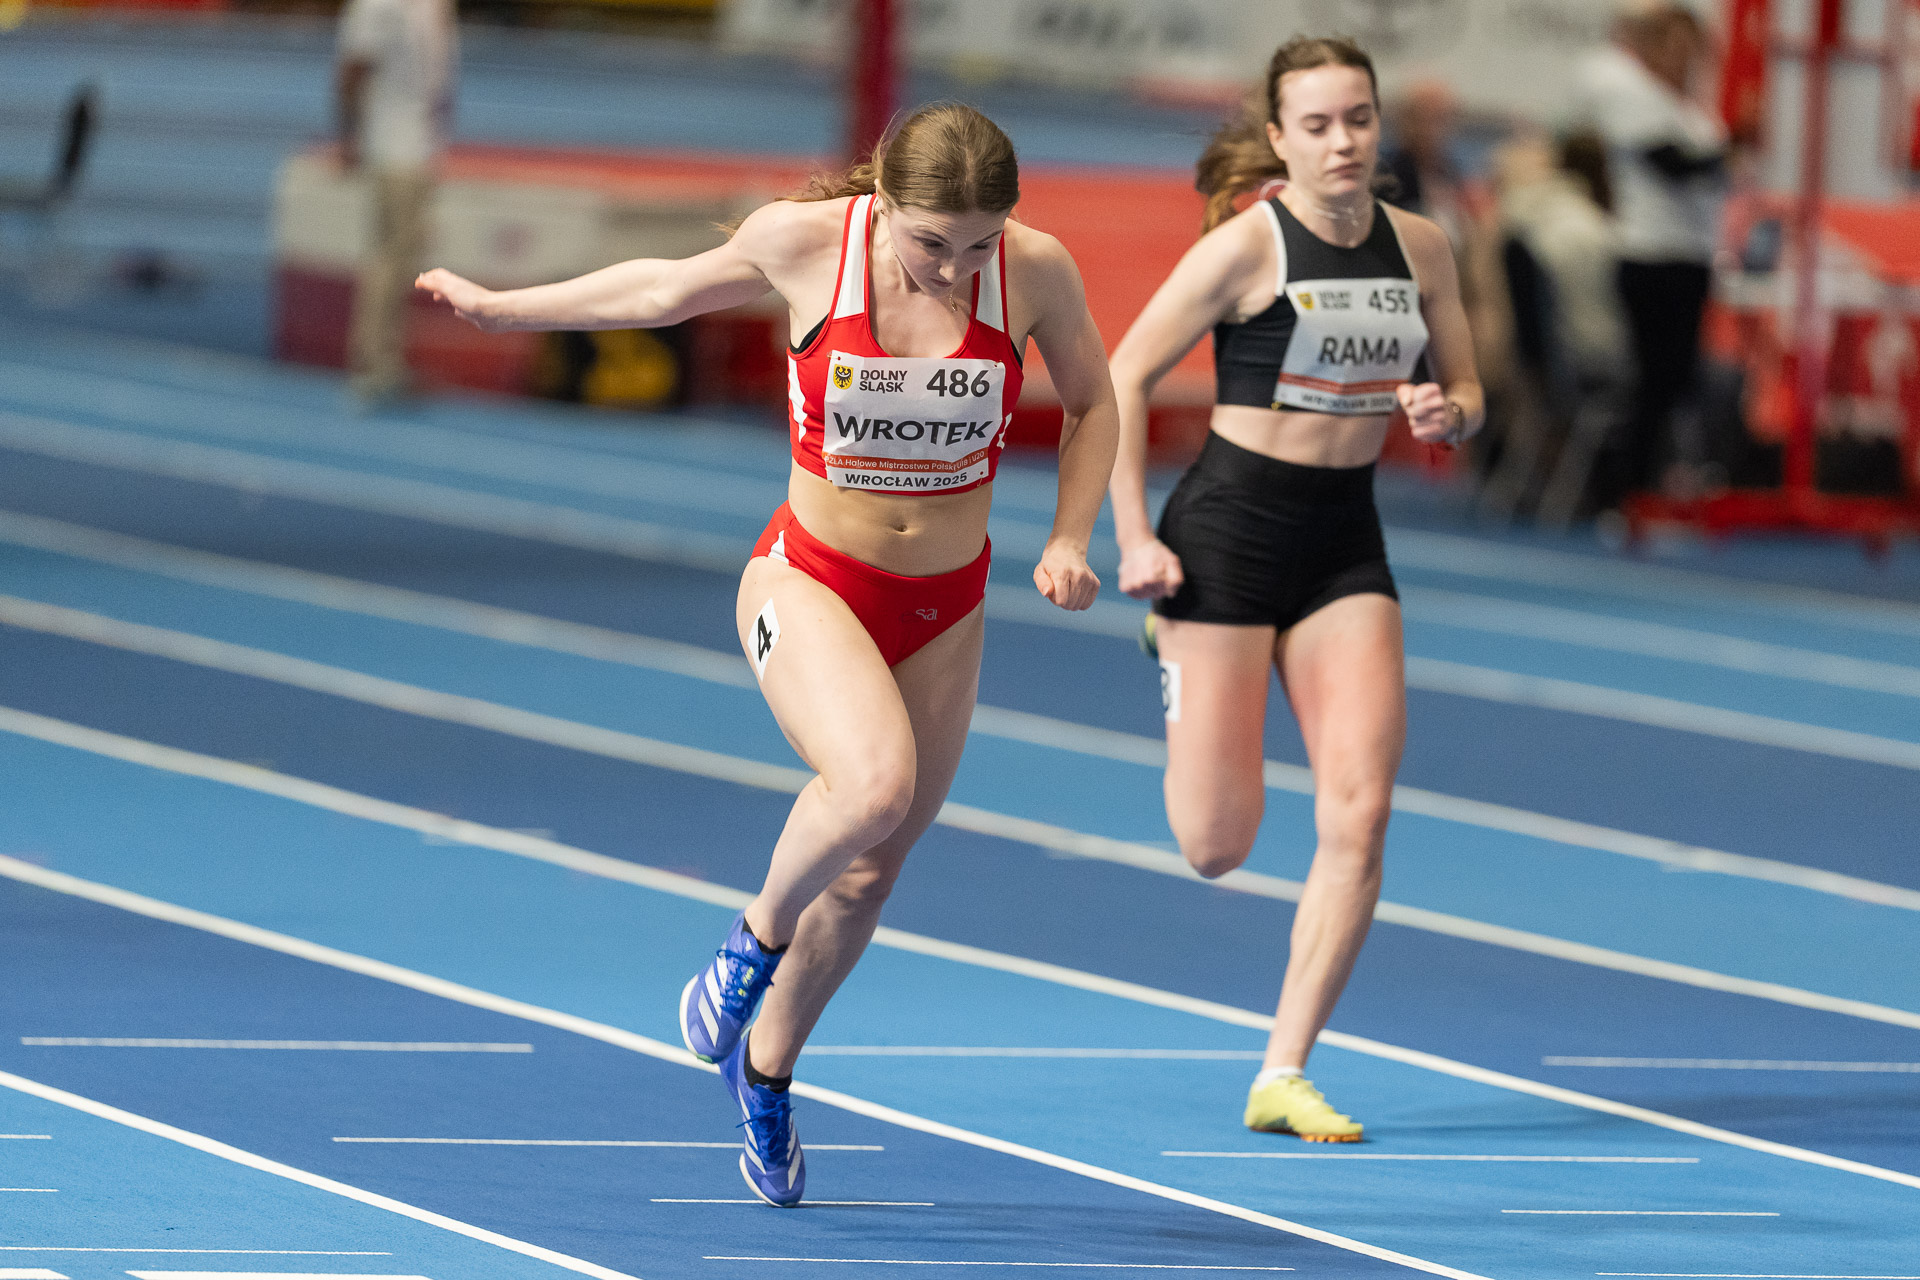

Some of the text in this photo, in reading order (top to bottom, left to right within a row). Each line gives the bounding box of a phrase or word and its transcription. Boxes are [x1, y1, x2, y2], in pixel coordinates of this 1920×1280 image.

[1369, 288, 1410, 313] 455
[1319, 336, 1399, 365] RAMA
[859, 380, 904, 393] ŚLĄSK
[860, 370, 907, 380] DOLNY
[926, 369, 990, 397] 486
[833, 412, 993, 446] WROTEK
[845, 459, 877, 468] Halowe
[879, 461, 930, 470] Mistrzostwa
[971, 451, 985, 462] U20
[845, 472, 967, 487] WROCŁAW 2025
[757, 614, 772, 662] 4
